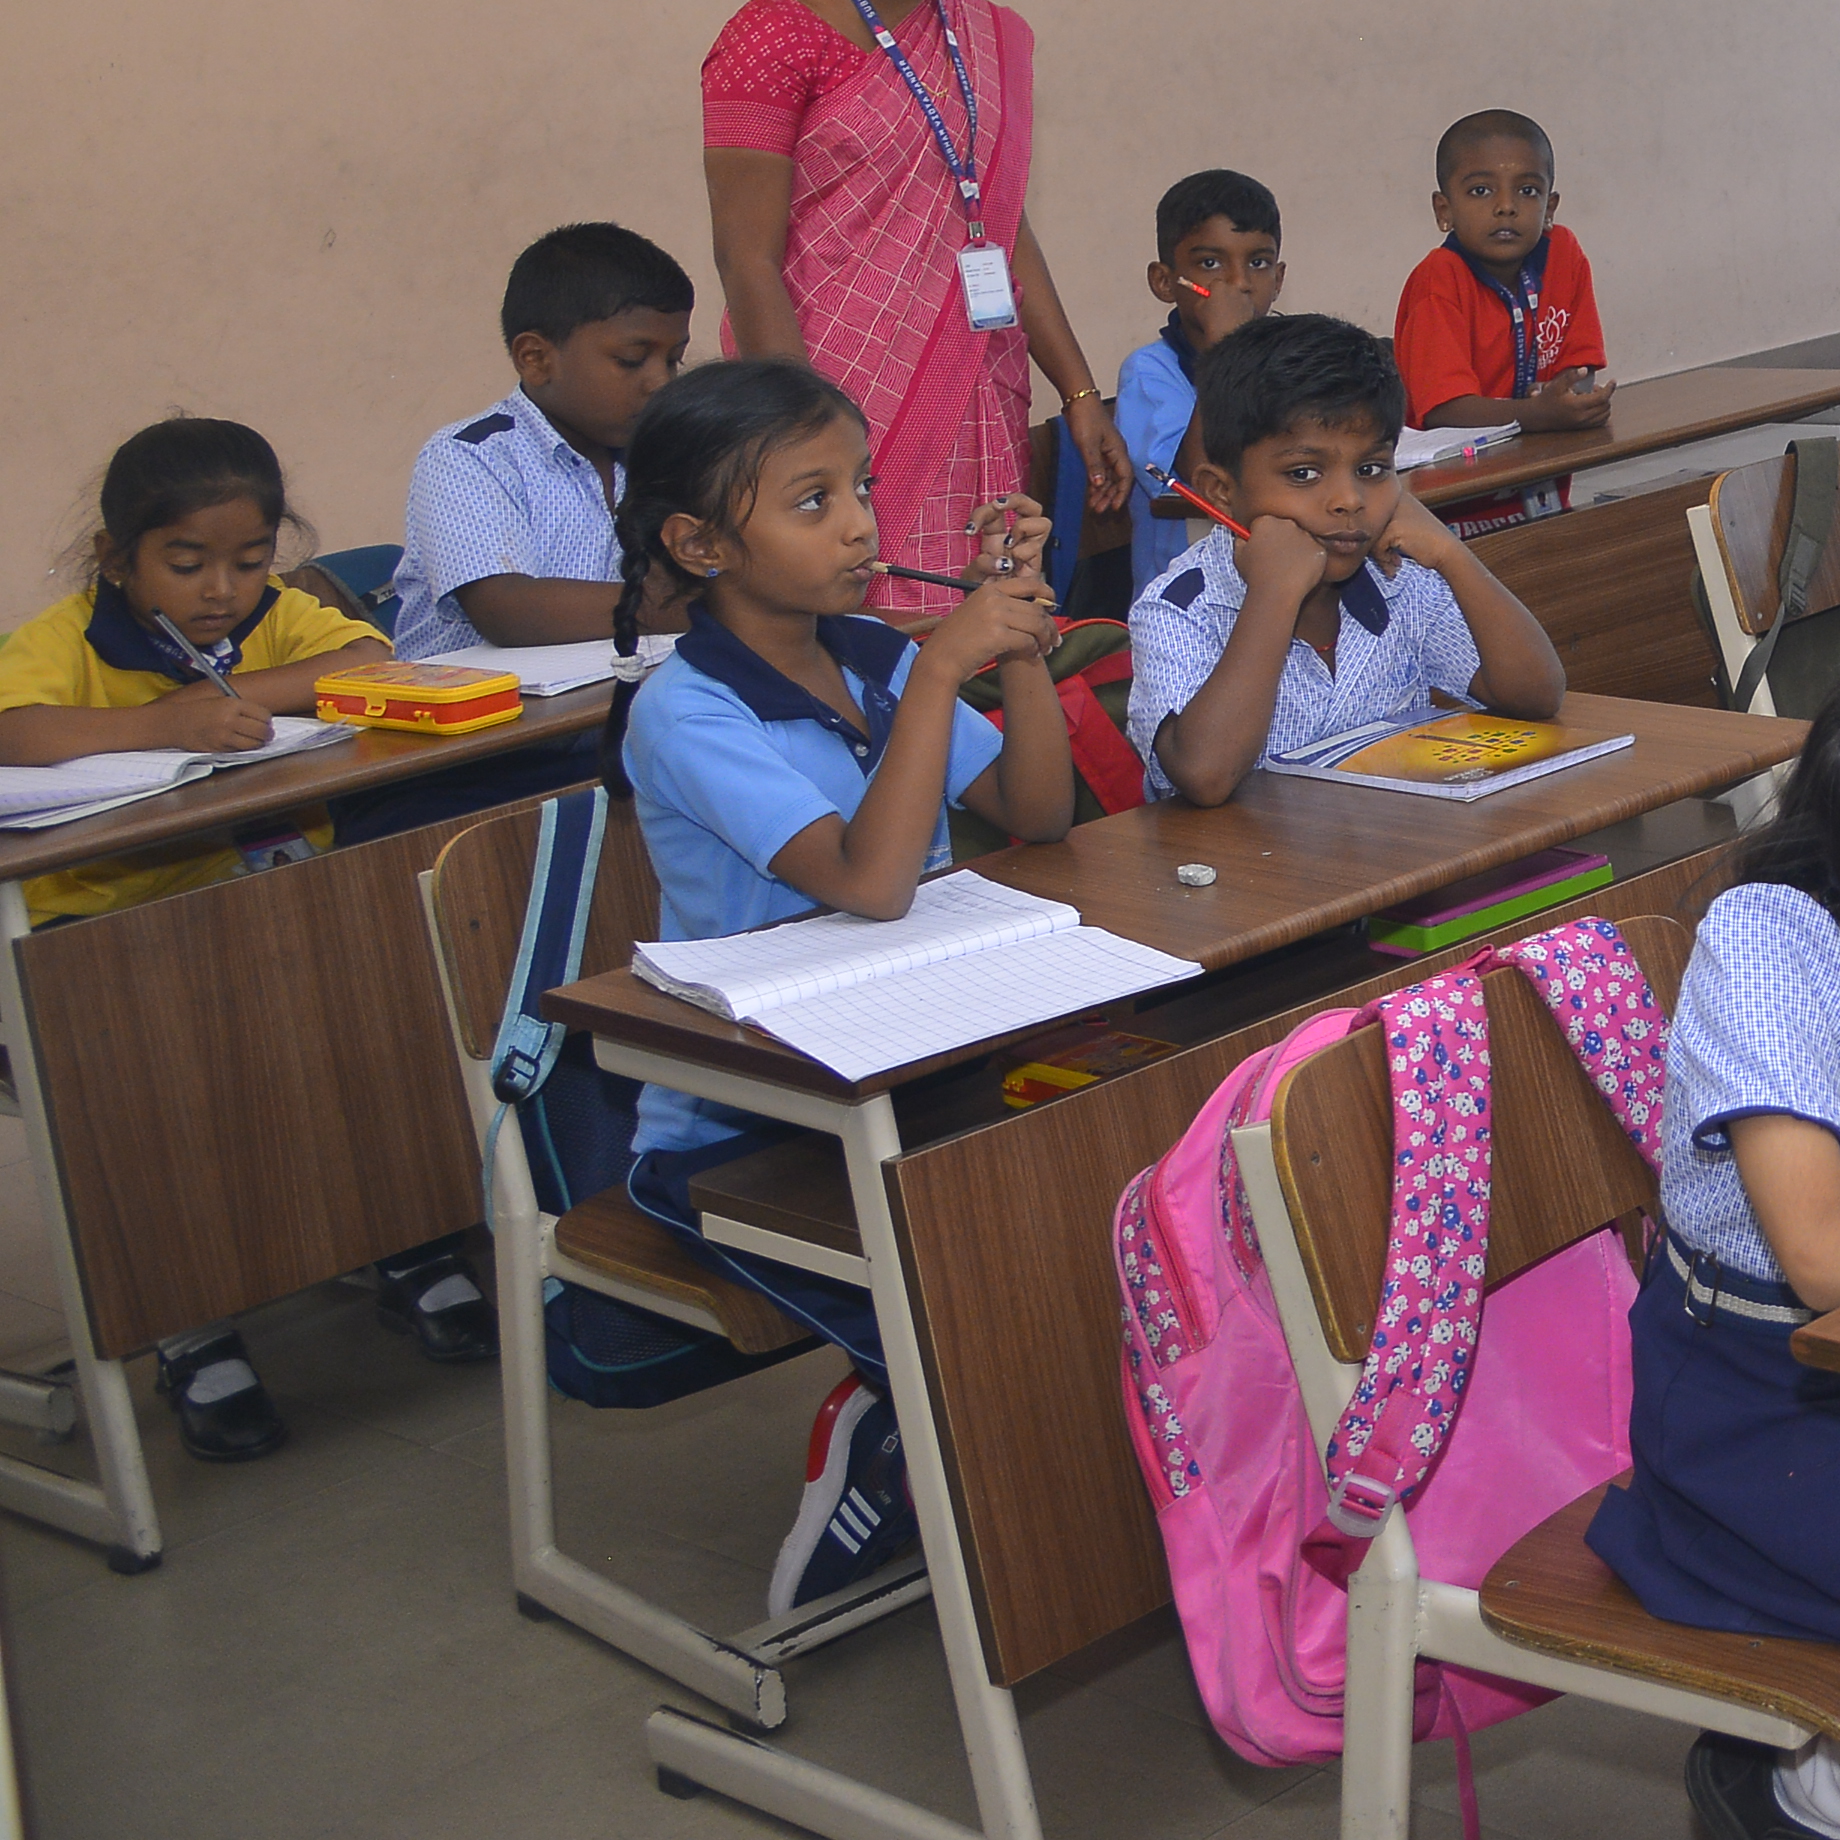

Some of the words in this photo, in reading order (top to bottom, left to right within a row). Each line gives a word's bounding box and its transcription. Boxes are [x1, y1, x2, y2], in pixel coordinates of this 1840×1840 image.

[899, 60, 924, 96] MANDIR
[922, 95, 940, 128] VIDYA
[939, 128, 959, 166] SUBHAM
